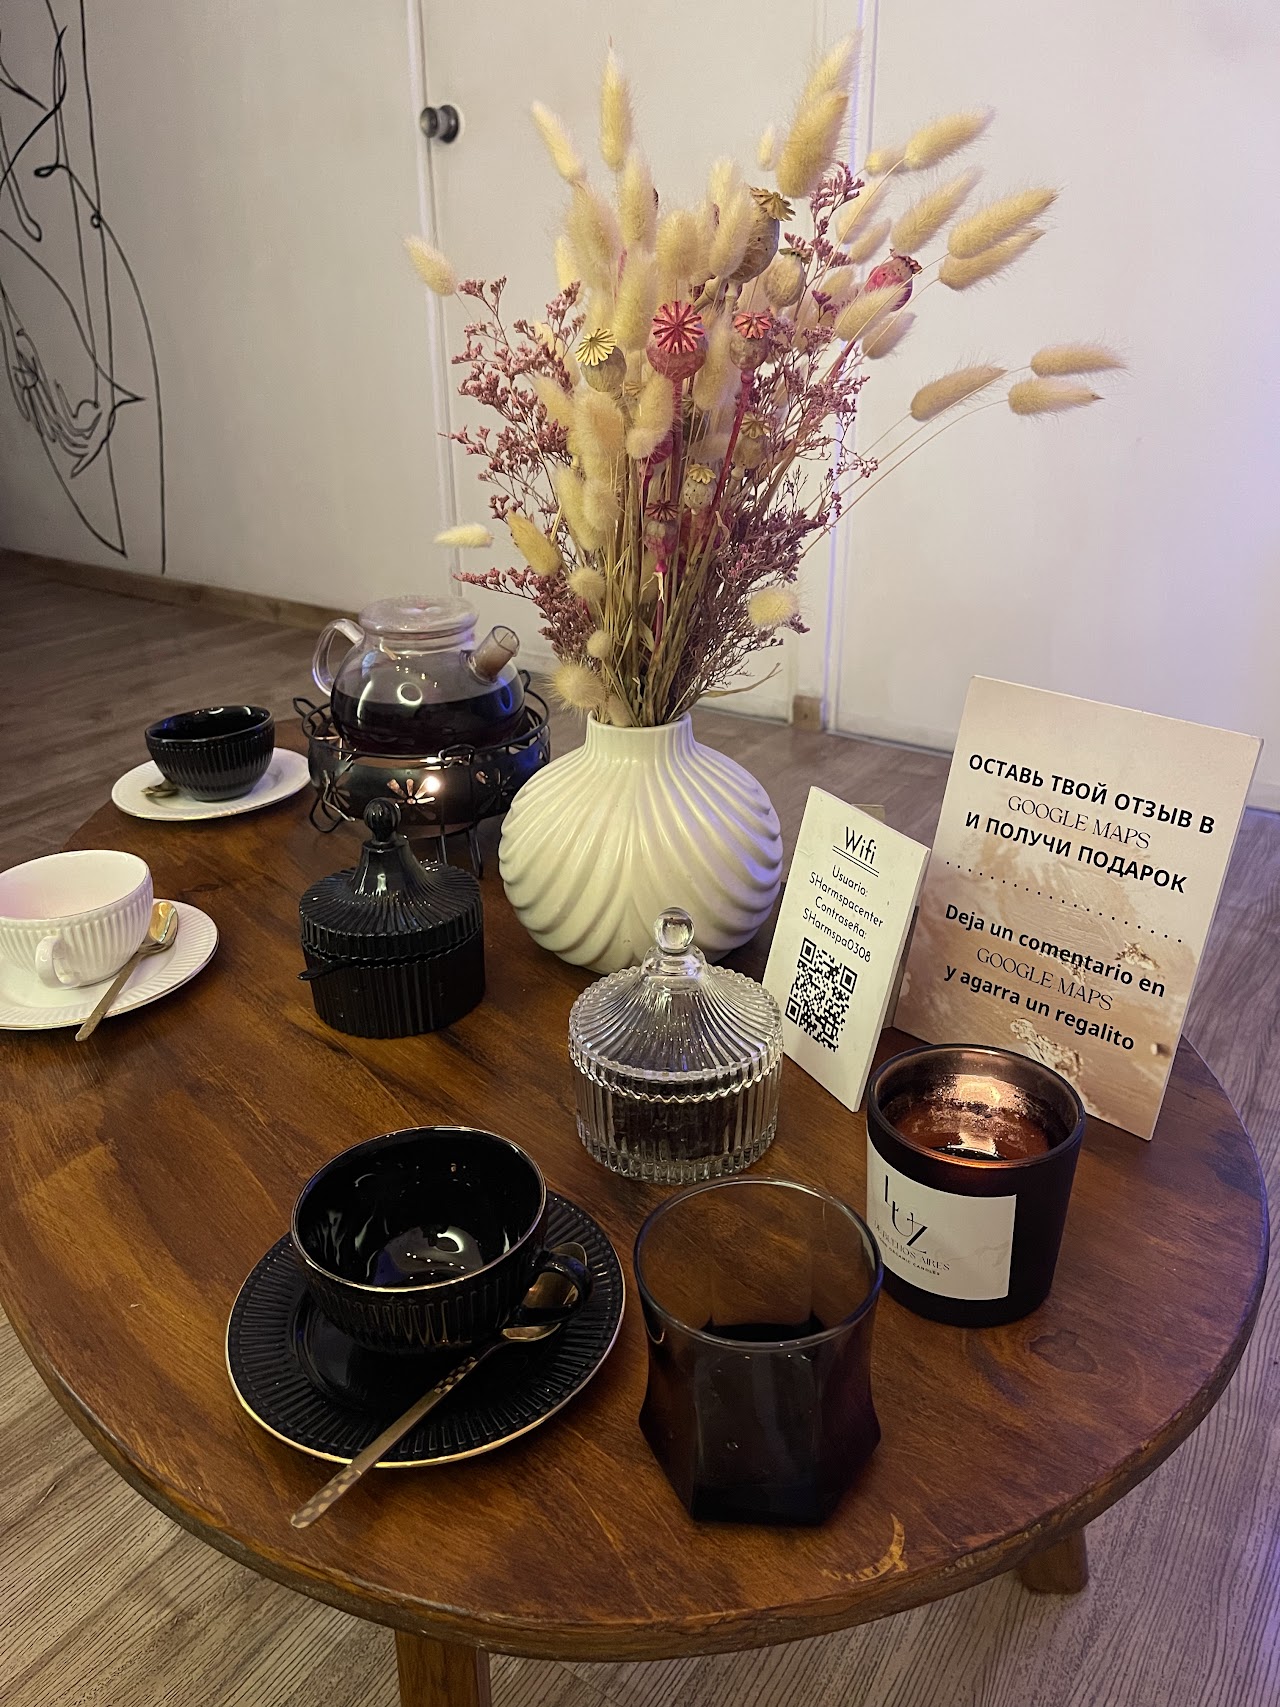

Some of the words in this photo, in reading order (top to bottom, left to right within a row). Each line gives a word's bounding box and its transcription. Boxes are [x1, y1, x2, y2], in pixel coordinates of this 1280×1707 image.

[969, 754, 1044, 788] ОСТАВЬ
[1051, 774, 1108, 805] ТВОЙ
[1114, 793, 1193, 828] ОТЗЫВ
[1199, 815, 1215, 835] В
[1007, 795, 1089, 832] GOOGLE
[1092, 819, 1151, 849] MAPS
[845, 826, 877, 864] Wifi
[965, 811, 980, 829] И
[985, 817, 1071, 857] ПОЛУЧИ
[1077, 845, 1188, 893] ПОДАРОК
[809, 871, 884, 928] SHarmspacenter
[832, 864, 868, 897] Usuario:
[802, 907, 871, 963] SHarmspa0308
[815, 896, 867, 939] Contraseña:
[945, 903, 985, 931] Deja
[990, 923, 1014, 942] un
[1018, 933, 1133, 985] comentario
[1139, 977, 1166, 997] en
[943, 964, 957, 982] y
[960, 971, 1020, 1005] agarra
[1025, 996, 1050, 1017] un
[1054, 1008, 1134, 1050] regalito
[976, 947, 1054, 988] GOOGLE
[1057, 977, 1114, 1011] MAPS
